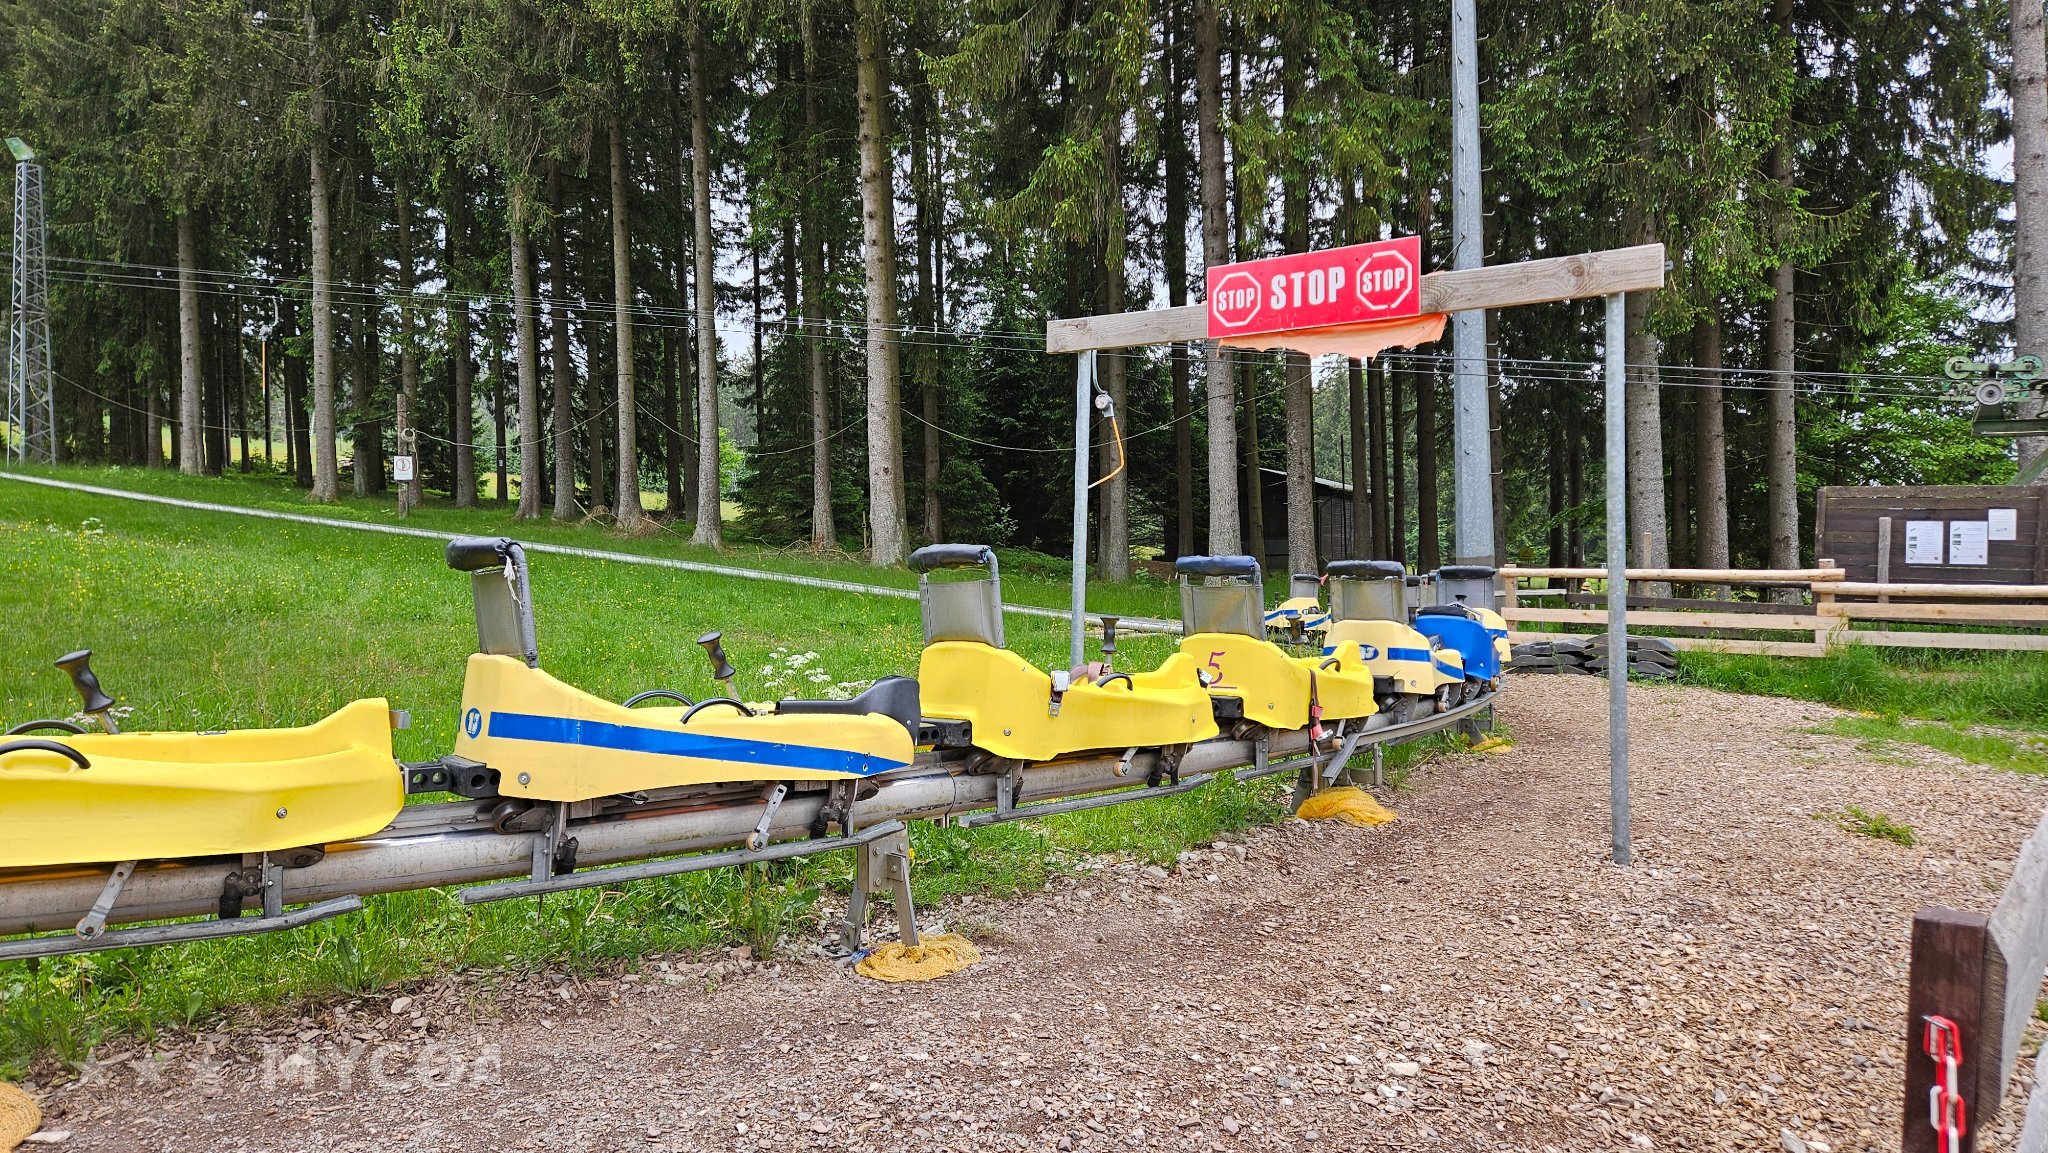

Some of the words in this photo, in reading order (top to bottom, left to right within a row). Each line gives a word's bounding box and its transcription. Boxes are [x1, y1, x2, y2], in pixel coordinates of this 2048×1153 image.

[1218, 288, 1255, 312] STOP
[1270, 266, 1345, 310] STOP
[1362, 267, 1405, 294] STOP
[1208, 651, 1226, 685] 5
